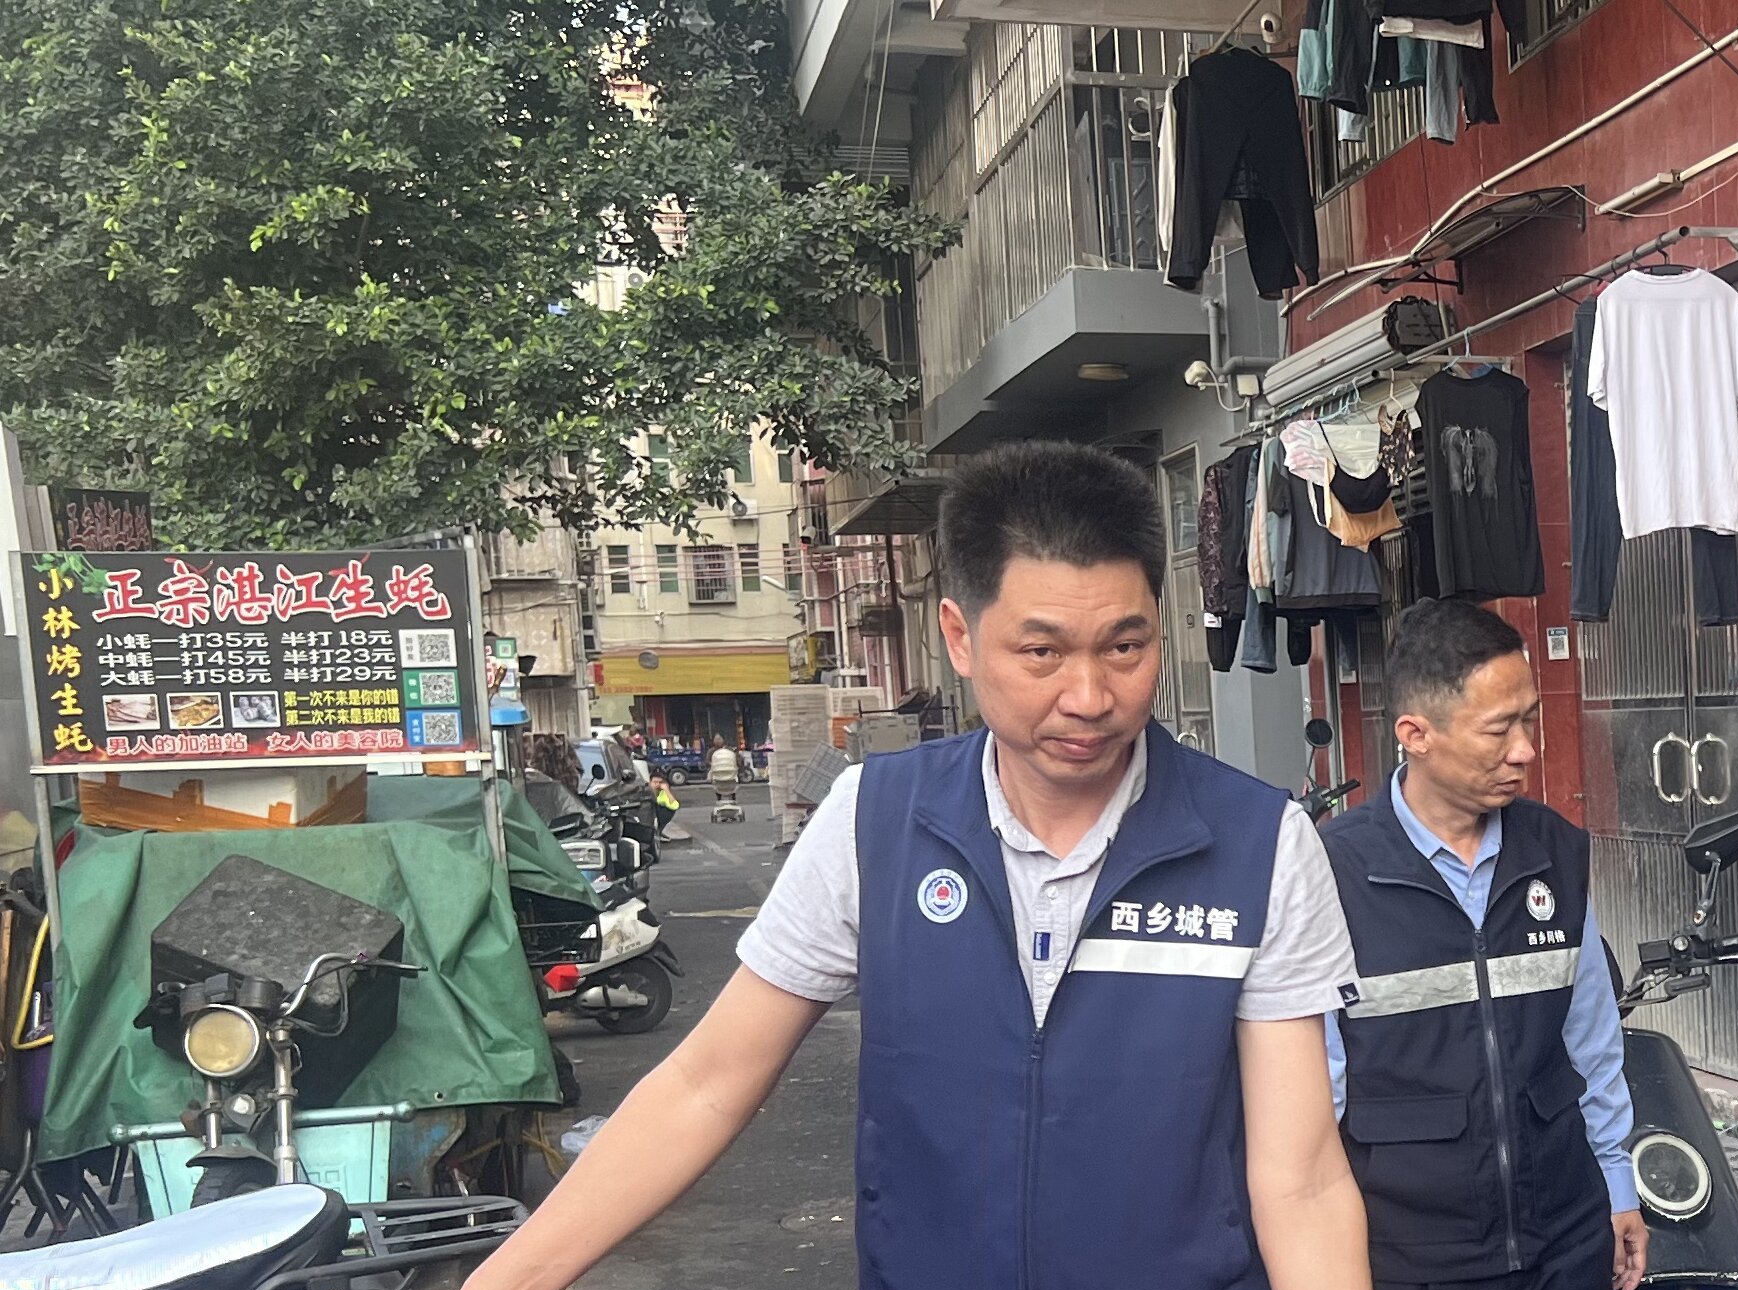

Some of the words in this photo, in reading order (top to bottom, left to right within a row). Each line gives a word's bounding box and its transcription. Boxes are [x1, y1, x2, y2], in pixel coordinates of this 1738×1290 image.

[92, 560, 452, 628] 正宗湛江生蚝
[96, 631, 269, 650] 小蚝一打35元
[280, 629, 393, 647] 半打18元
[39, 568, 94, 752] 小林烤生蚝
[98, 650, 272, 668] 中蚝一打45元
[282, 648, 396, 665] 半打23元
[100, 668, 272, 687] 大蚝一打58元
[283, 666, 397, 684] 半打29元
[284, 688, 399, 708] 第一次不来是你的错
[285, 708, 401, 726] 第二次不来是我的错
[106, 733, 248, 755] 男人的加油站
[267, 729, 403, 751] 女人的美容院
[1111, 901, 1239, 941] 西乡城管
